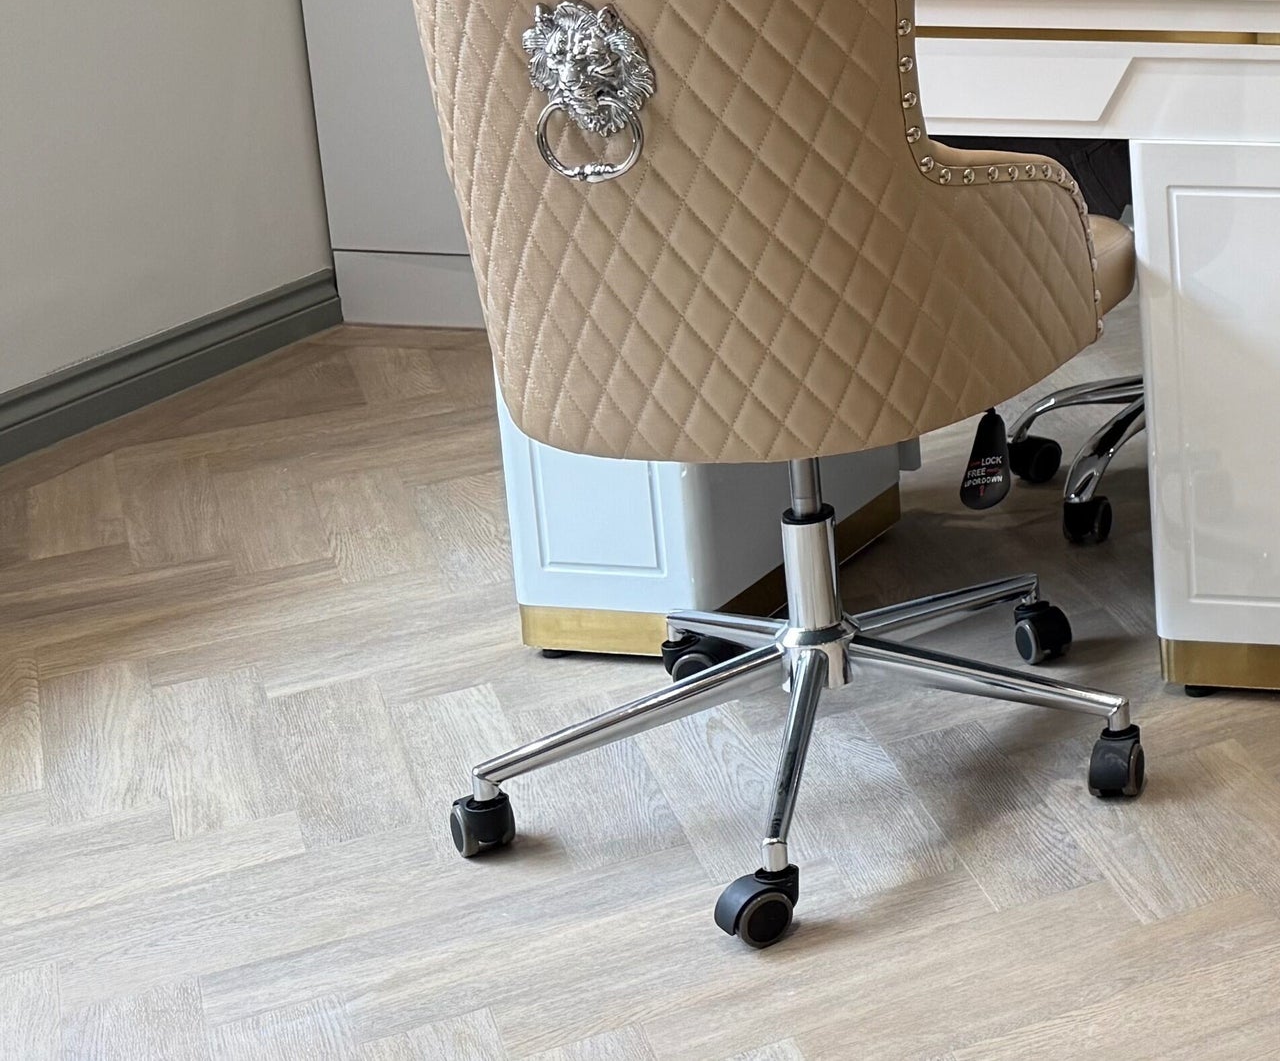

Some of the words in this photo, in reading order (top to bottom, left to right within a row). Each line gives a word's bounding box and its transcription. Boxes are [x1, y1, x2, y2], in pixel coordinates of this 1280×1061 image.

[981, 456, 1002, 466] LOCK
[967, 467, 986, 478] FREE
[981, 475, 1003, 485] DOWN
